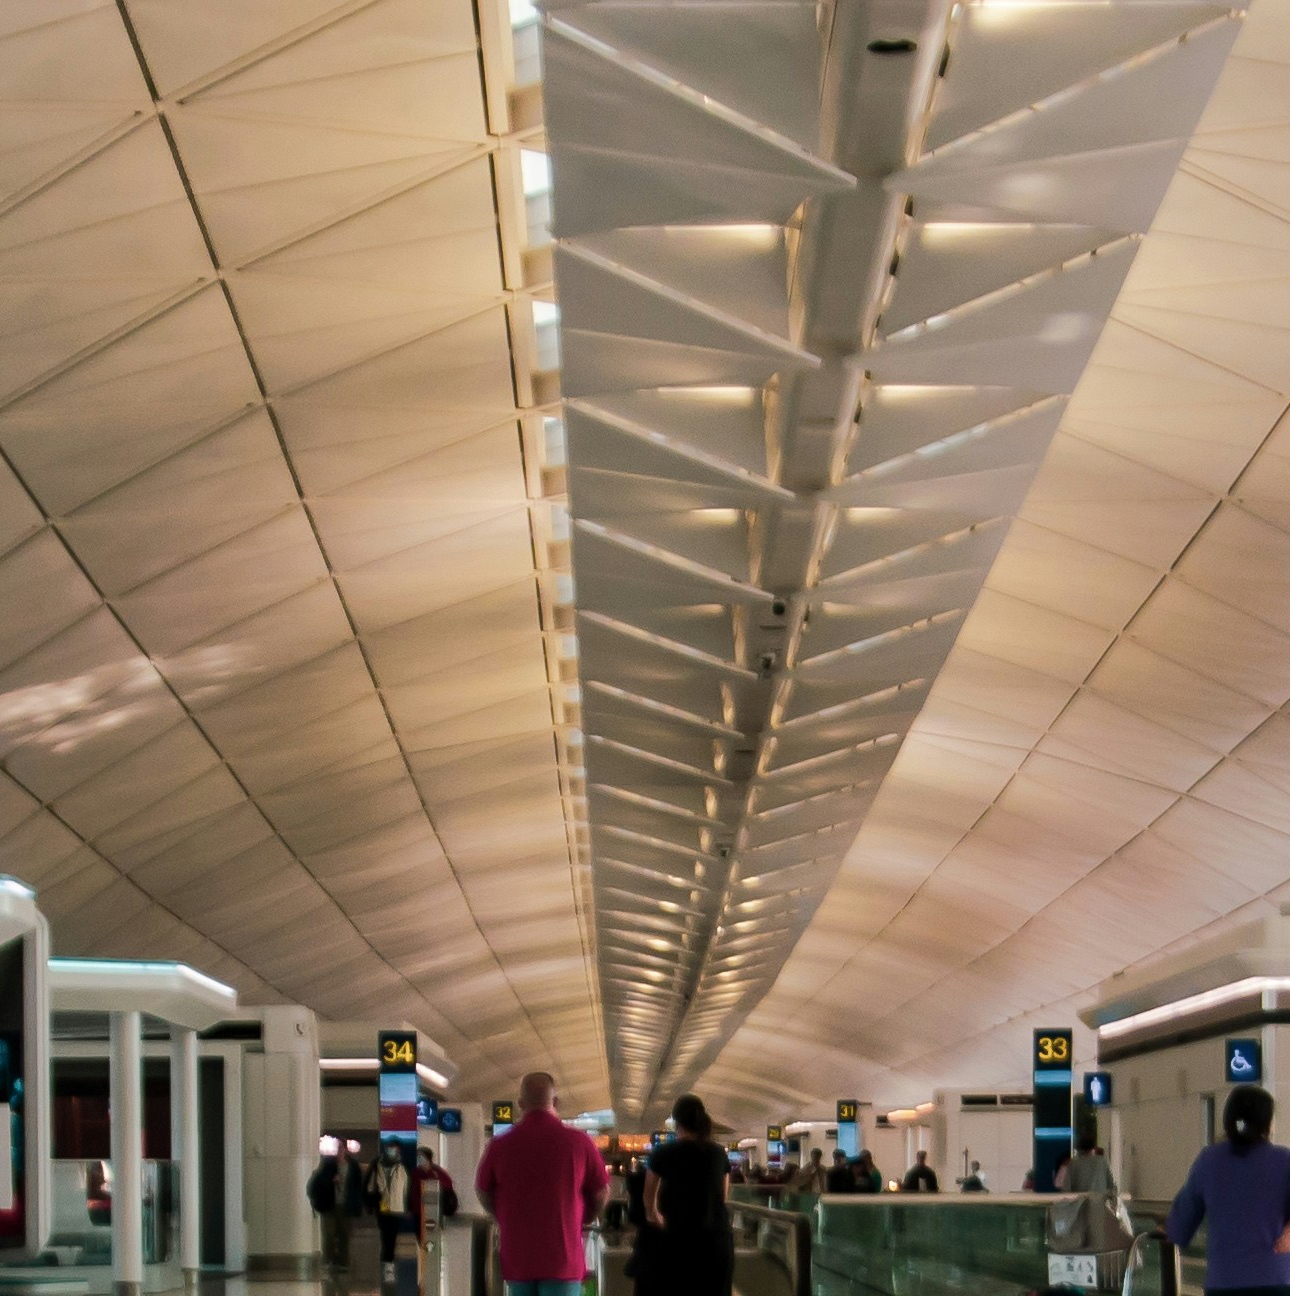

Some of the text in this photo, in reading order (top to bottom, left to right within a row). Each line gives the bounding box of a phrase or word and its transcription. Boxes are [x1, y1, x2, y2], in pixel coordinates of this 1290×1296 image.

[383, 1040, 414, 1062] 34
[1038, 1037, 1068, 1062] 33
[495, 1105, 511, 1119] 32
[840, 1104, 854, 1117] 31
